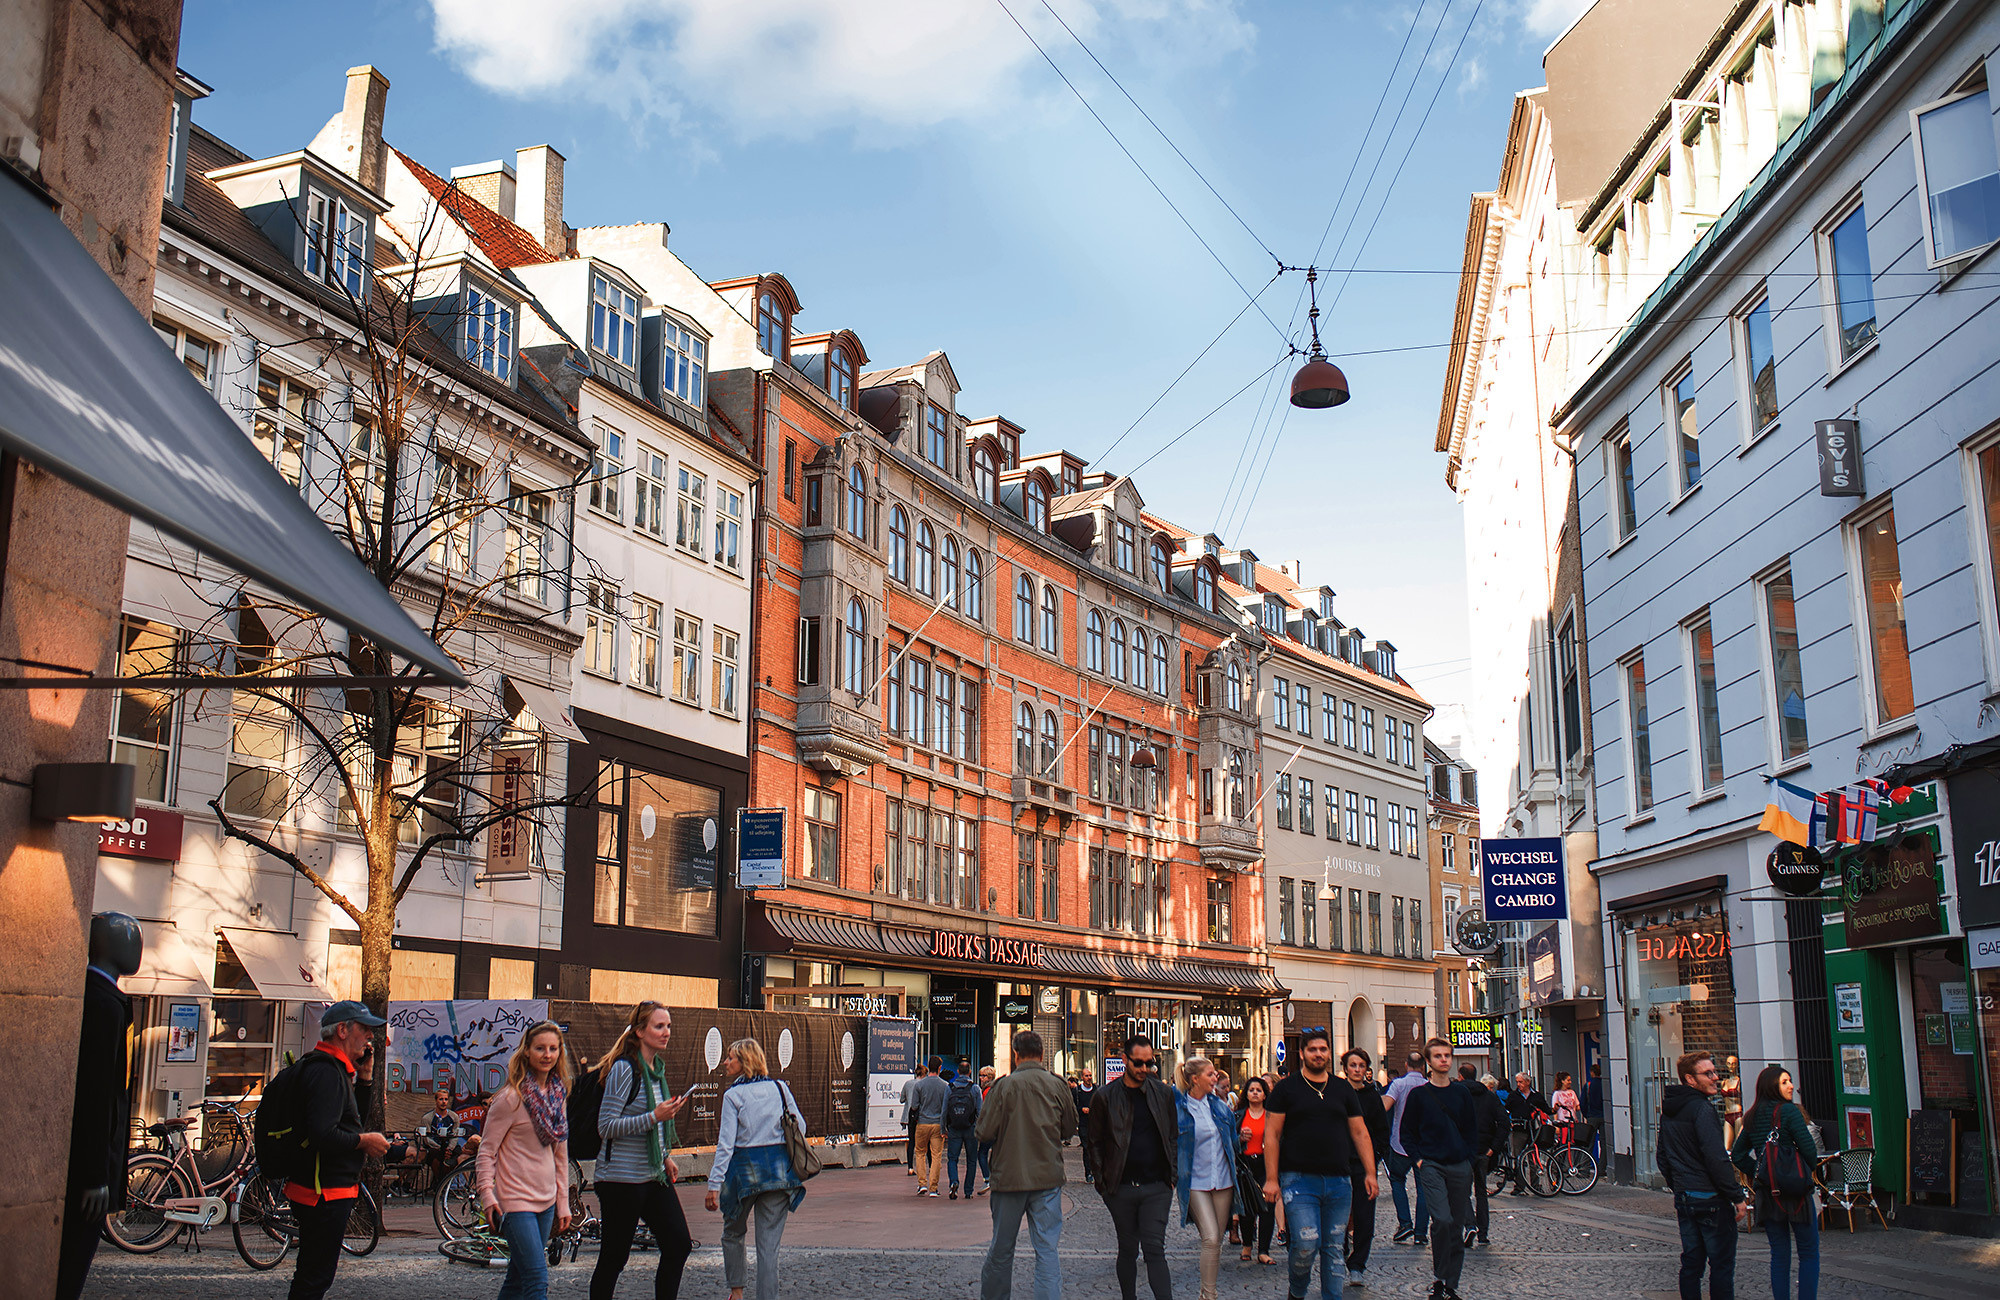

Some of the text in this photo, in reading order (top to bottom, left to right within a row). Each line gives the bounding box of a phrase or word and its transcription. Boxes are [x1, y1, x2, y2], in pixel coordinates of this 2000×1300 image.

[1487, 851, 1558, 865] WECHSEL
[1327, 856, 1381, 878] LOUISES HUS
[1777, 864, 1820, 876] GUINNESS
[1491, 872, 1557, 886] CHANGE
[1495, 893, 1556, 907] CAMBIO
[931, 930, 1044, 966] JORCKS PASSAGE
[848, 996, 887, 1013] STORY
[1190, 1014, 1244, 1030] HAVANNA
[1450, 1019, 1491, 1032] FRIENDS
[1205, 1032, 1230, 1043] SHOES
[1458, 1032, 1492, 1046] BRGRS
[875, 1080, 892, 1092] Capital
[470, 1108, 485, 1119] FLY
